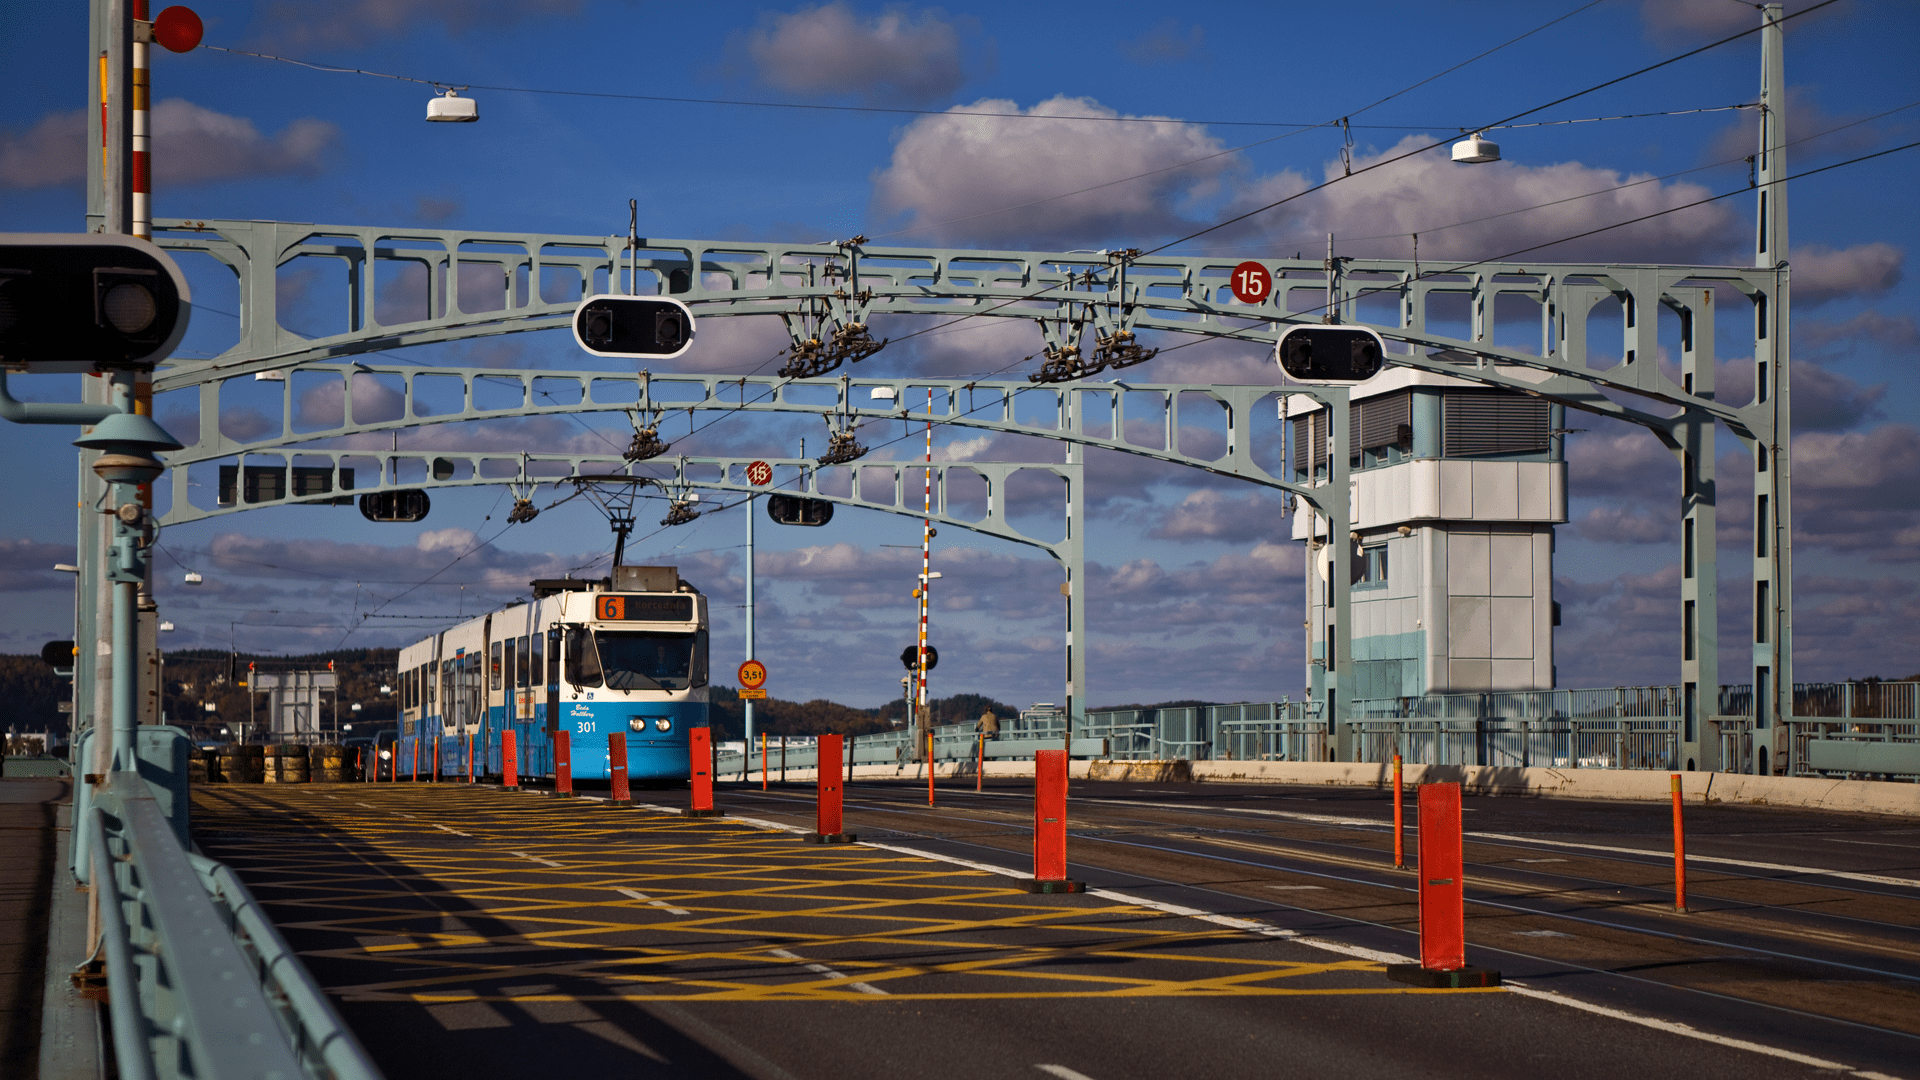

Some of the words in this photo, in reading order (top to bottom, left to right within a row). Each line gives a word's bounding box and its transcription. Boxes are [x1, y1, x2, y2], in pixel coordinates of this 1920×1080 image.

[1238, 270, 1262, 295] 15
[752, 466, 766, 480] 15
[605, 599, 616, 617] 6
[577, 721, 595, 733] 301
